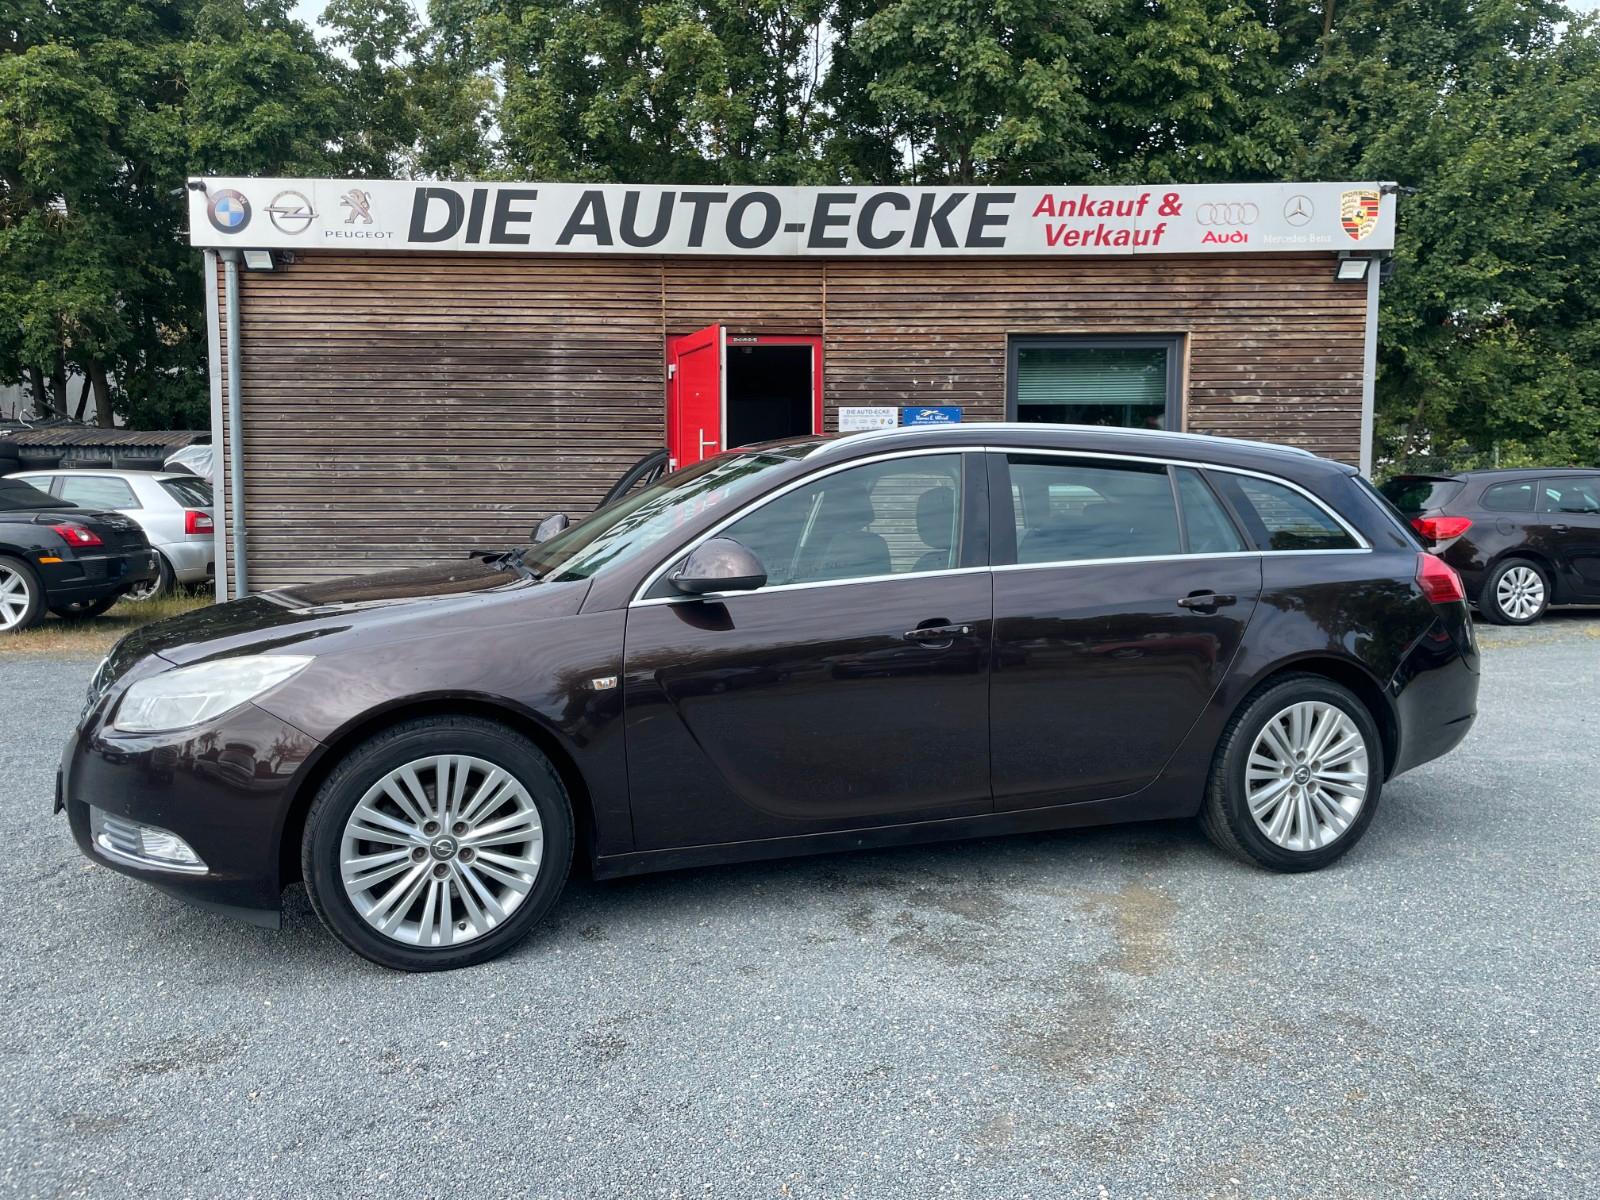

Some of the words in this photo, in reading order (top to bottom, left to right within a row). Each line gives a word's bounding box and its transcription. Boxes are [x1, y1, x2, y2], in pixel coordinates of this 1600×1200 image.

[1032, 192, 1151, 217] Ankauf
[1157, 192, 1184, 217] &
[407, 187, 538, 245] DIE
[555, 190, 1017, 250] AUTO-ECKE
[324, 230, 394, 239] PEUGEOT
[1044, 223, 1166, 247] Verkauf
[1201, 230, 1249, 244] Audi
